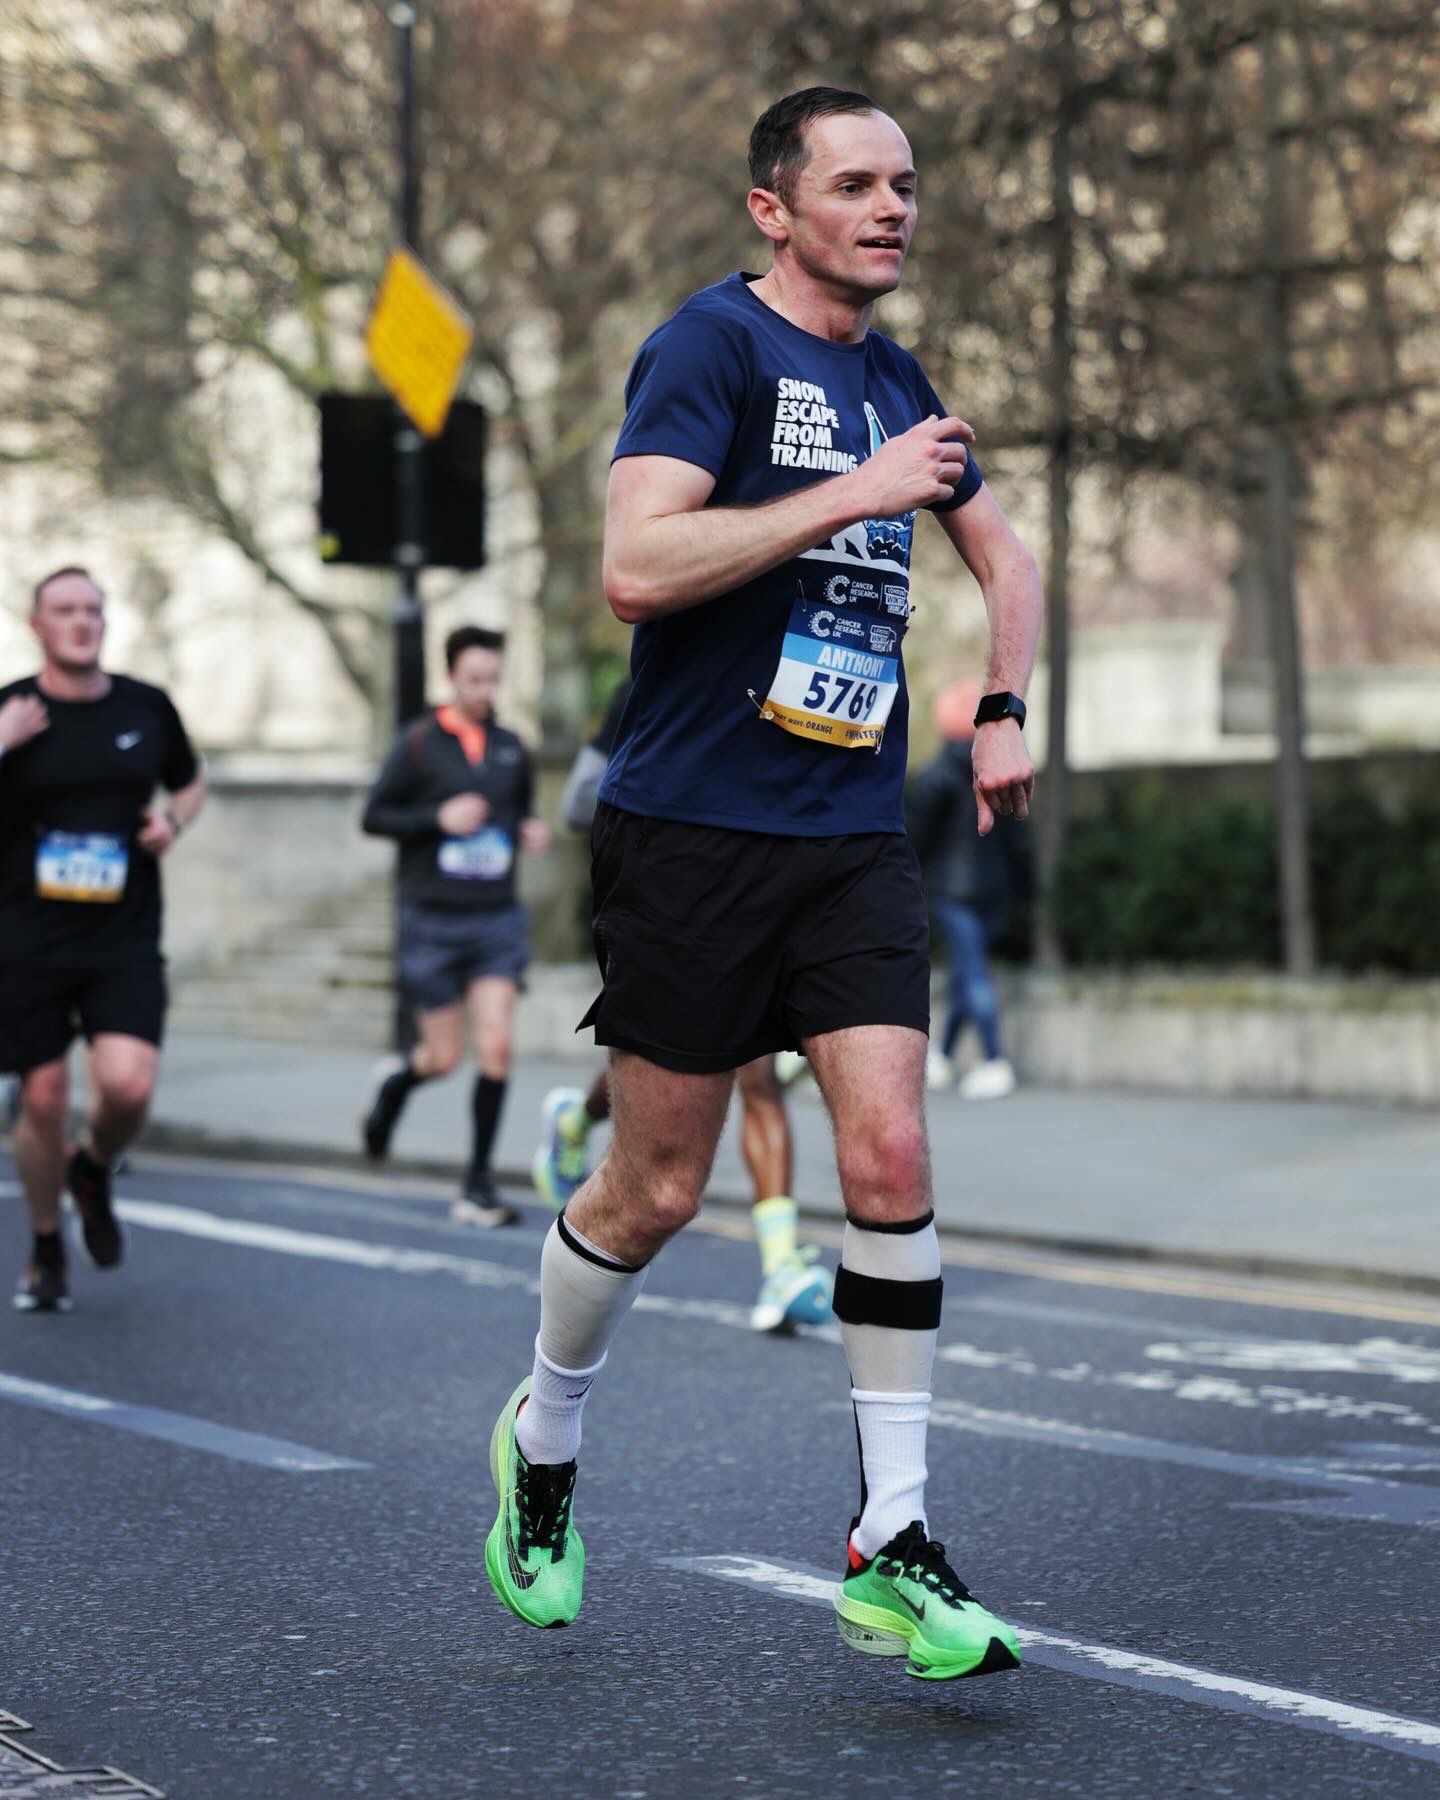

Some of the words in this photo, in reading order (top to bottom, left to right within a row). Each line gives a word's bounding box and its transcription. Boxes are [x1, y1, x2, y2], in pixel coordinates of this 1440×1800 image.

[777, 377, 827, 405] SNOW
[775, 400, 840, 429] ESCAPE
[772, 422, 833, 449] FROM
[770, 443, 858, 474] TRAINING
[850, 588, 878, 599] RESEARCH
[851, 581, 873, 590] CANCER
[834, 624, 865, 636] RESEARCH
[836, 618, 861, 629] CANCER
[817, 645, 886, 679] ANTHONY
[802, 671, 879, 722] 5769
[805, 721, 833, 734] ORANGE
